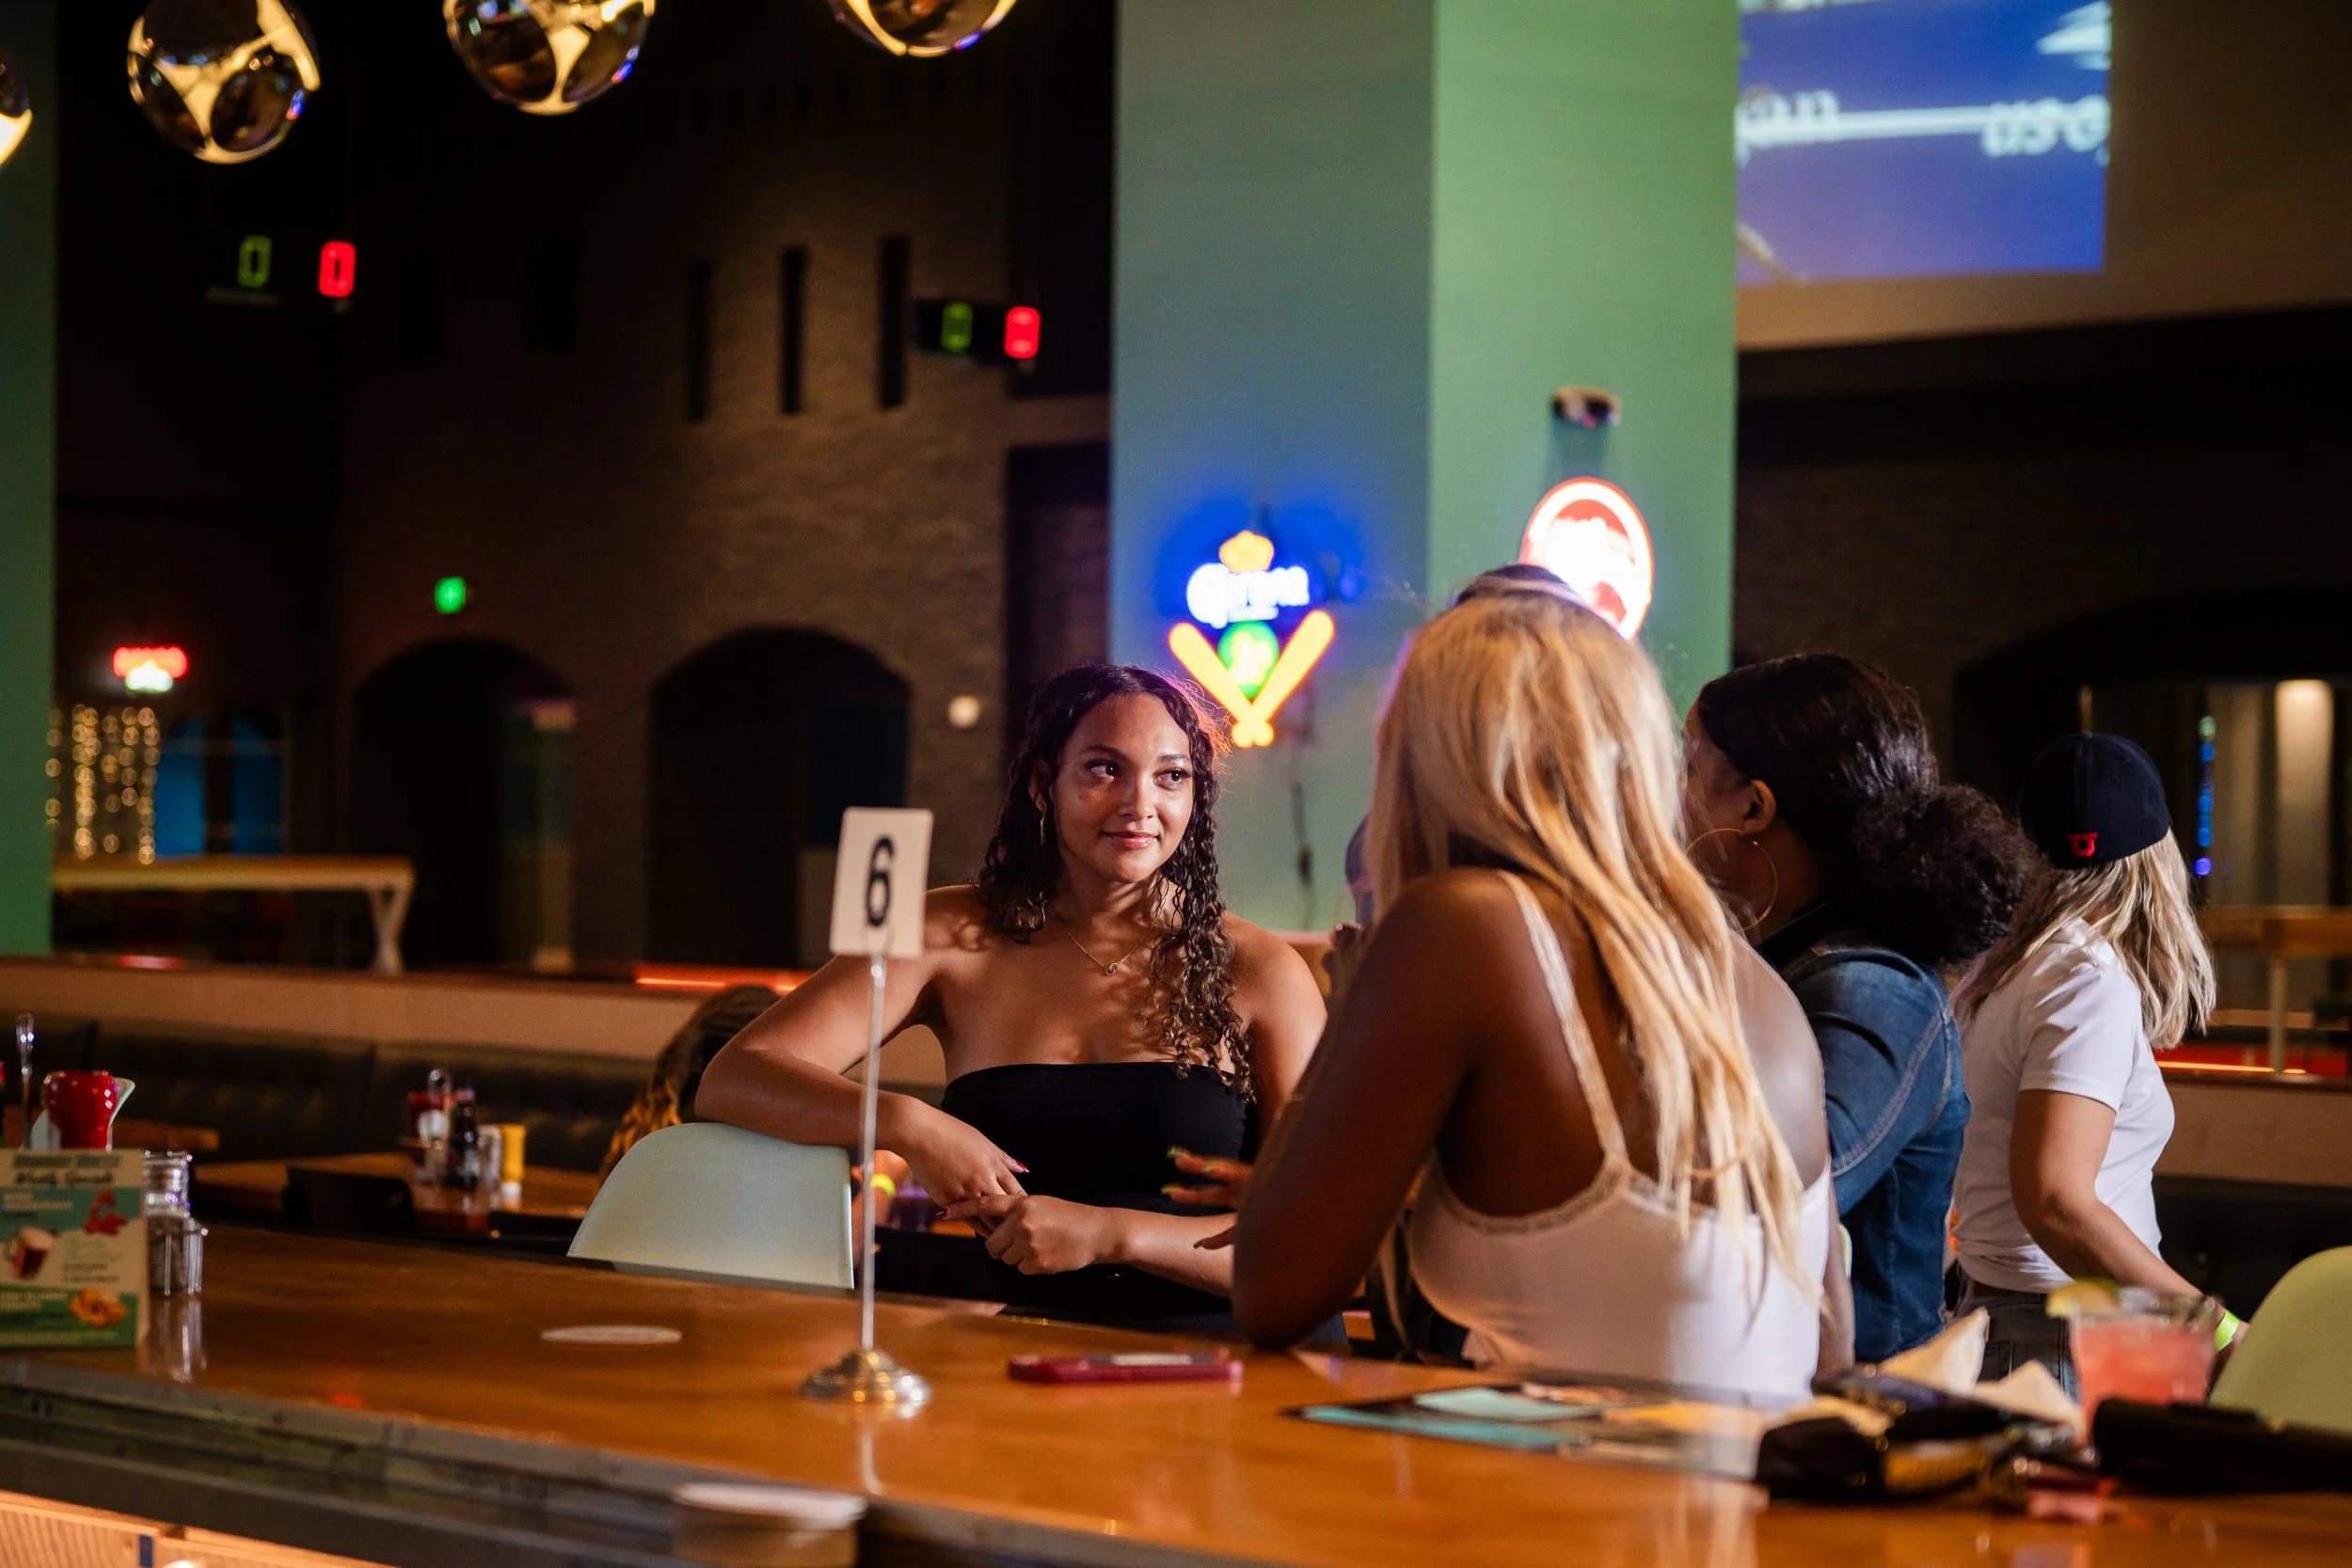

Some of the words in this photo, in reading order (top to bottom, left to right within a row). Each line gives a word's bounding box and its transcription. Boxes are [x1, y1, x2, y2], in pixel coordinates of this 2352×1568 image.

[238, 235, 272, 288] 0
[318, 241, 357, 297] 0
[2068, 832, 2098, 857] U
[866, 836, 895, 927] 6
